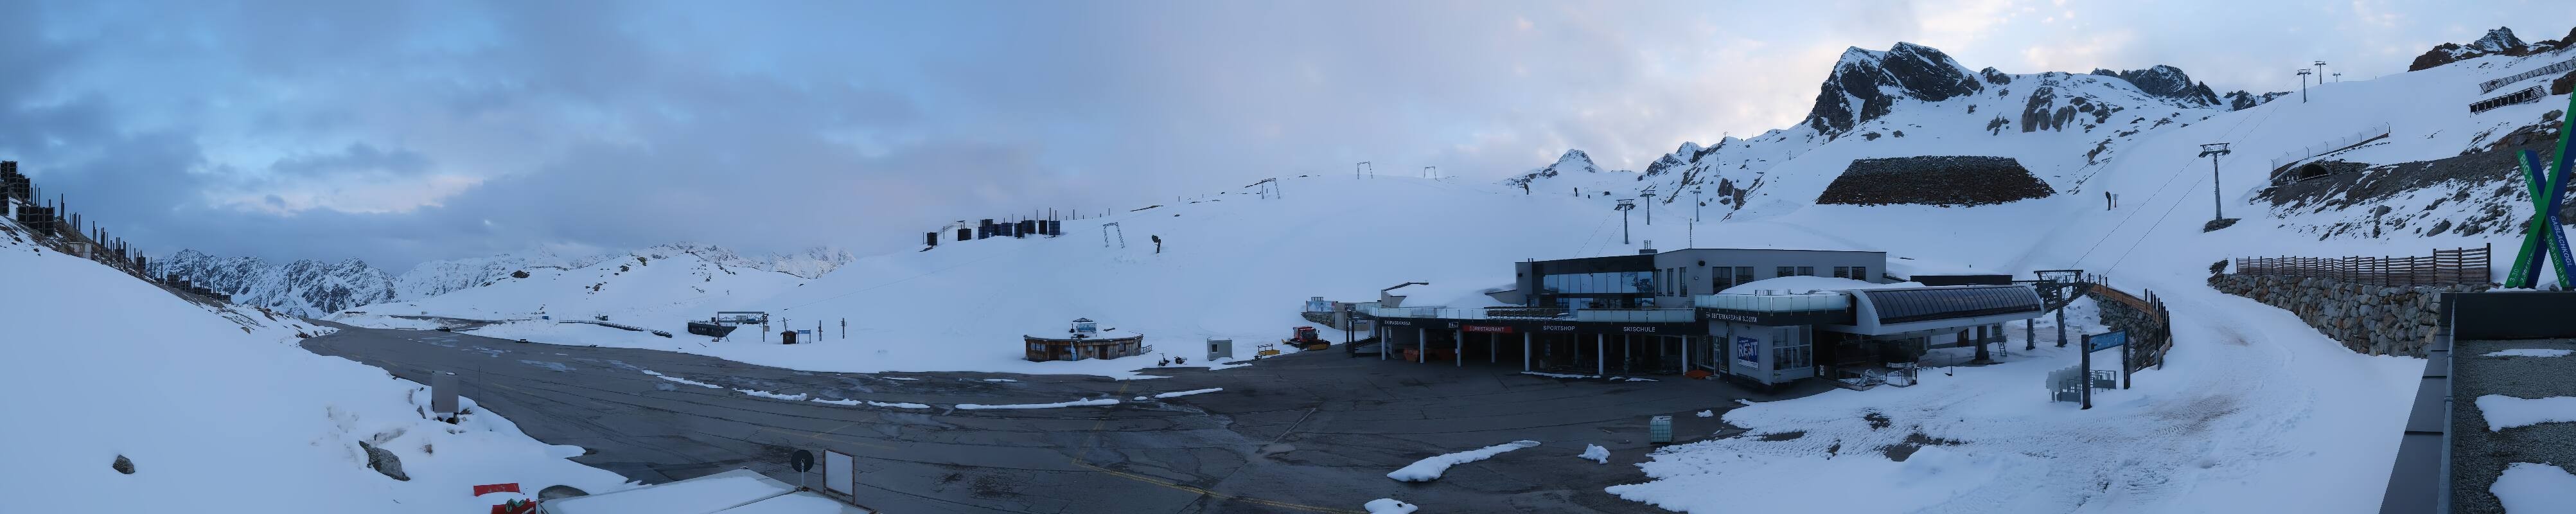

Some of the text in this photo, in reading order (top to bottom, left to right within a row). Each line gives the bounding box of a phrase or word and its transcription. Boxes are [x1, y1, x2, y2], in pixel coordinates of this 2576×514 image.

[2519, 154, 2533, 184] BIG 3
[2550, 215, 2573, 268] GAISLACHKOGL
